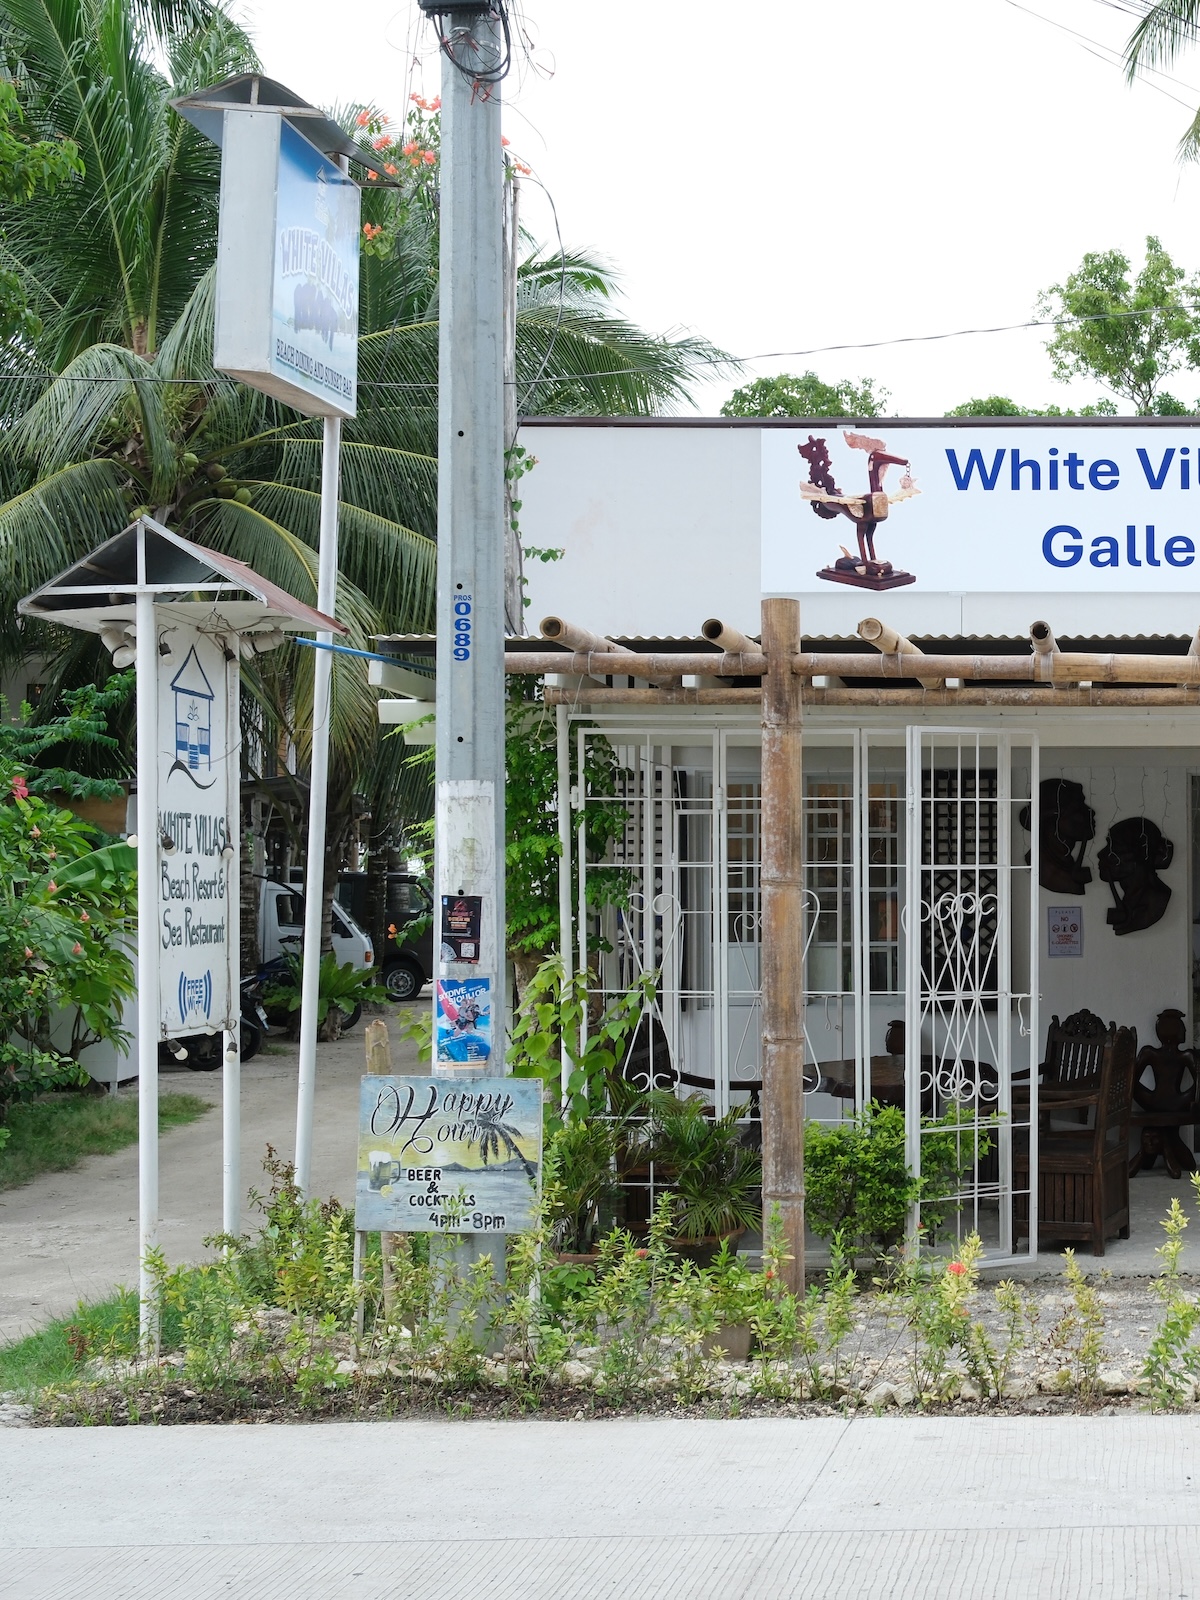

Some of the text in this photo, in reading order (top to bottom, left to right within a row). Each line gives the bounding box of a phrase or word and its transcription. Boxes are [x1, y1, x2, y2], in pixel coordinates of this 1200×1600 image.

[281, 227, 319, 277] WHITE
[319, 239, 354, 319] VILLAS
[276, 337, 353, 397] BEACH DINING AND SUNSET BAR
[945, 447, 1120, 491] White
[453, 602, 472, 661] 0689
[160, 810, 226, 857] WHITE VILLAS
[161, 860, 191, 901] Beach
[192, 861, 218, 902] Resort
[162, 906, 225, 949] Sea Restaurant
[187, 979, 203, 995] FREE
[408, 1169, 441, 1181] BEER
[427, 1181, 439, 1194] &
